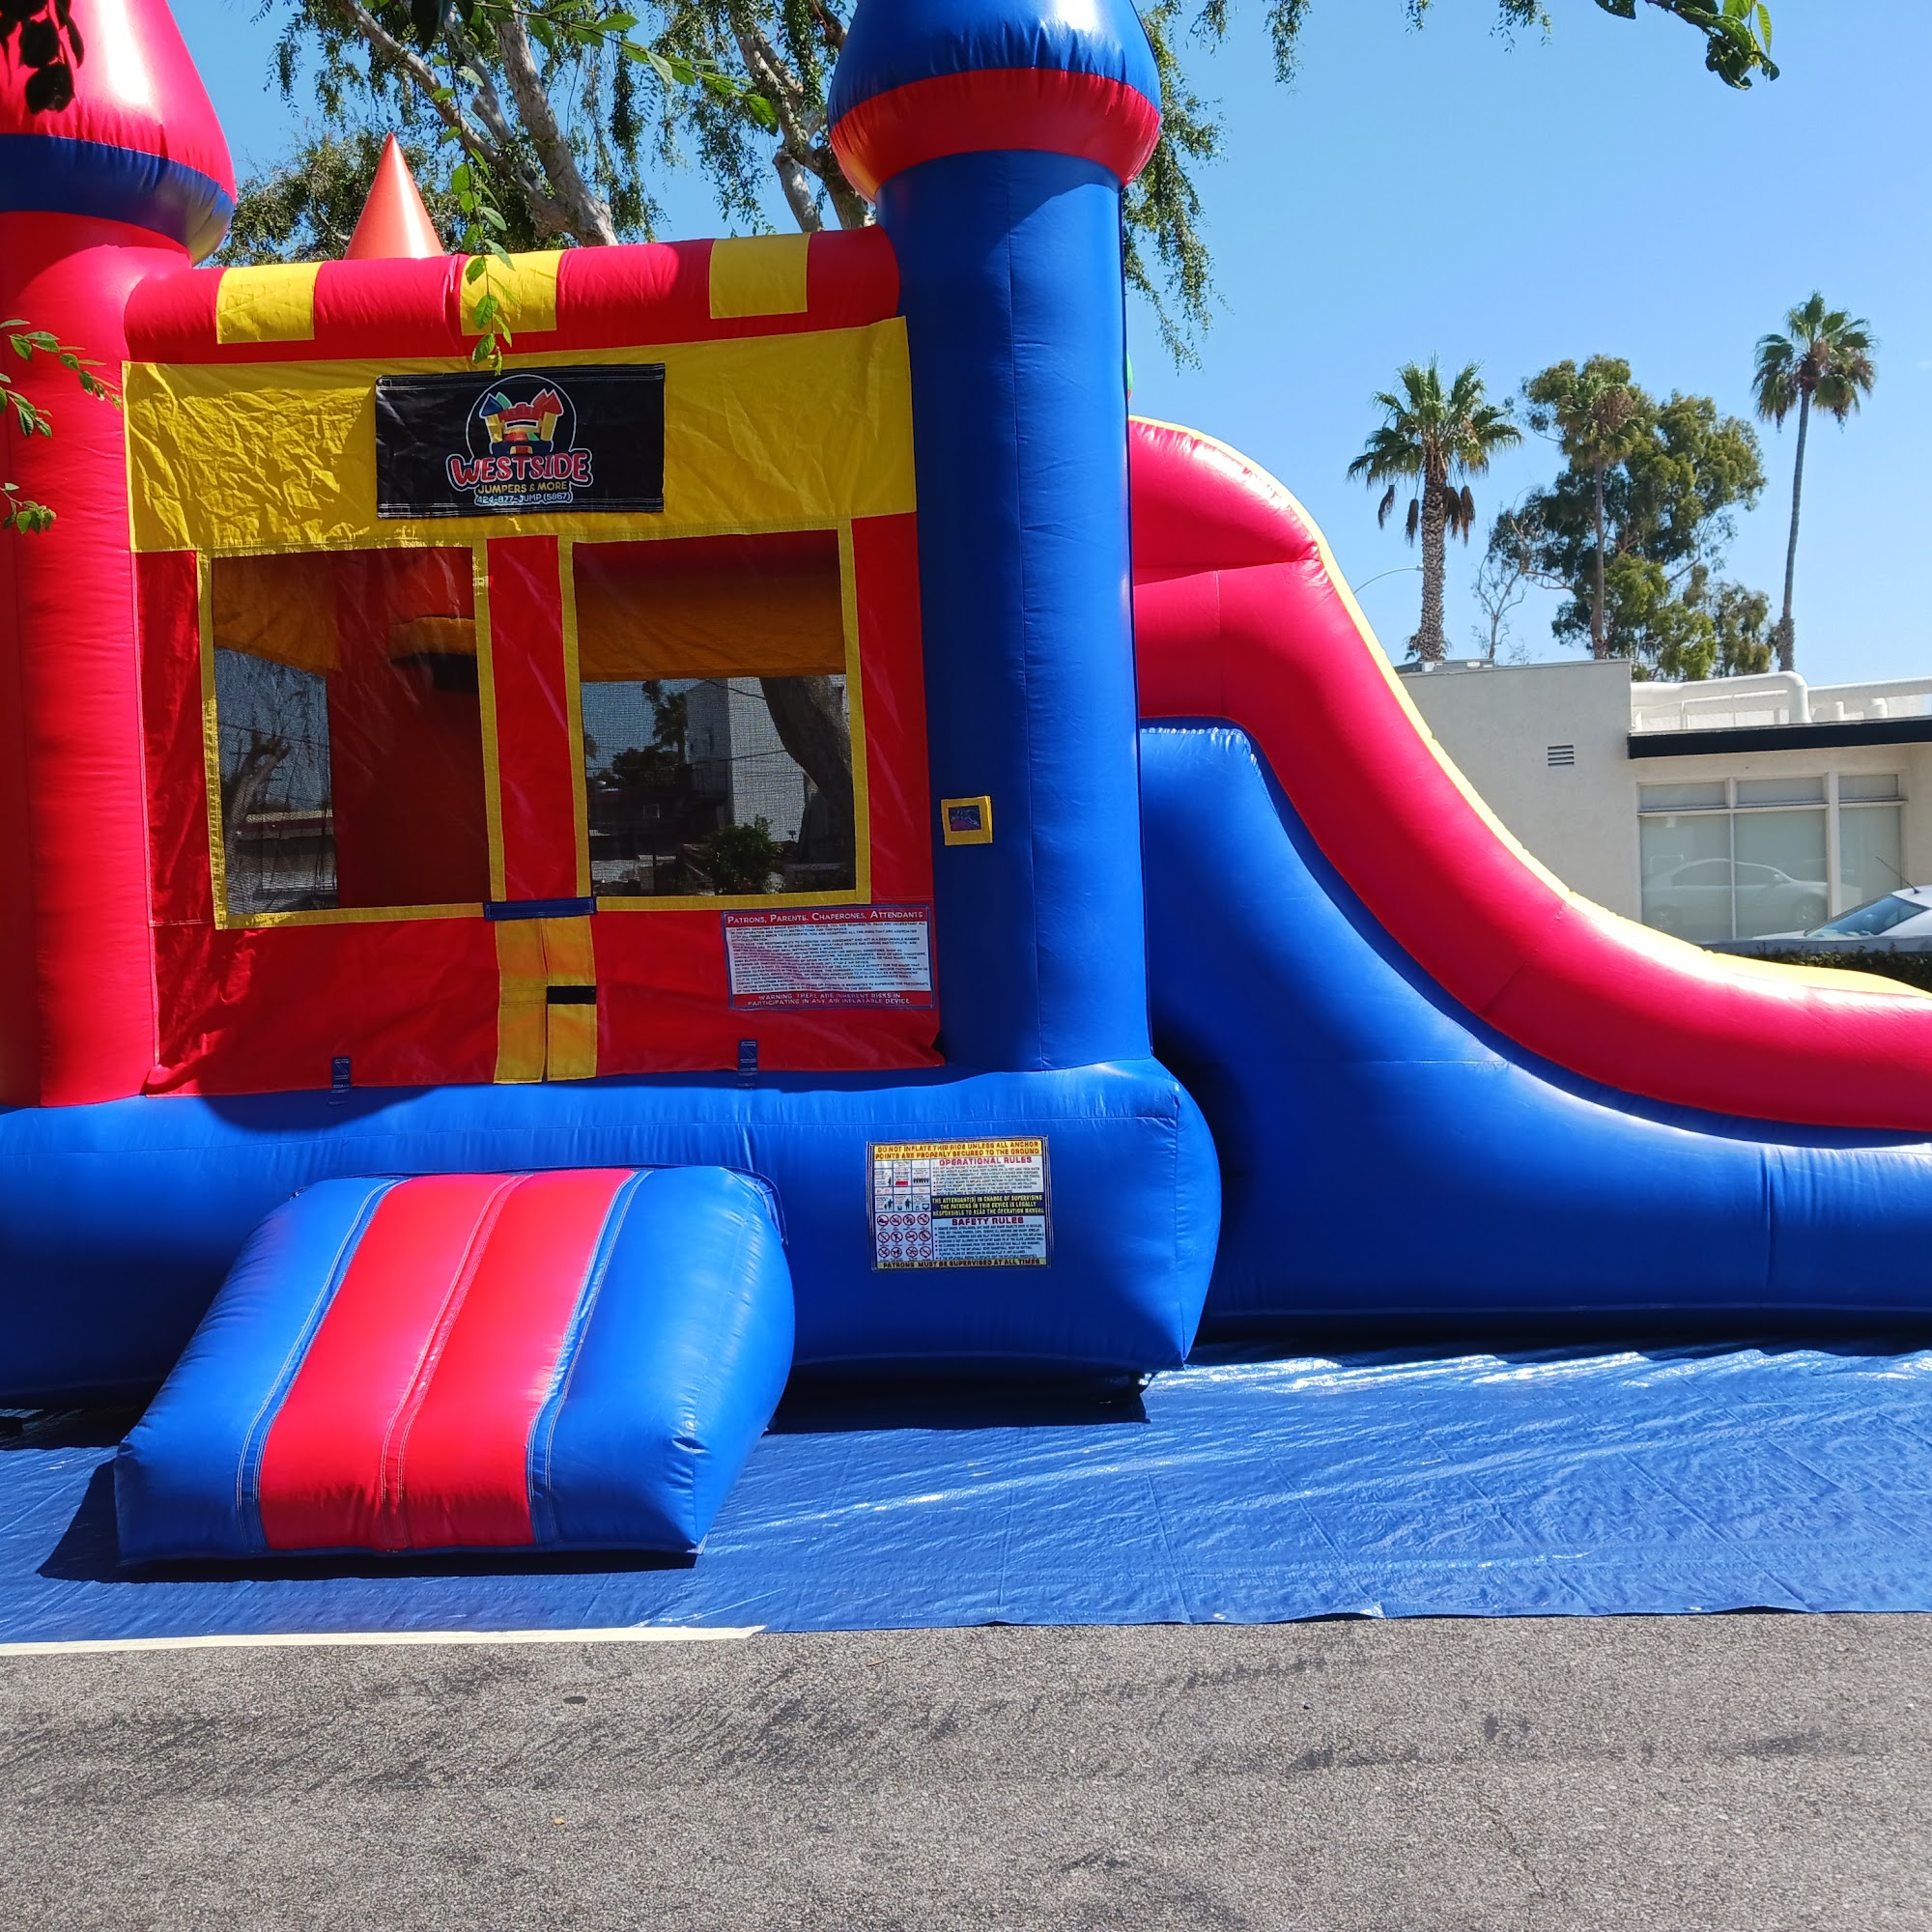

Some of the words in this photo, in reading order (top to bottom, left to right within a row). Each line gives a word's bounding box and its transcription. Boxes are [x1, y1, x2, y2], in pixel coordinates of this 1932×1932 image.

[450, 452, 589, 485] WESTSIDE
[477, 484, 527, 495] JUMPERS
[537, 481, 567, 491] MORE
[477, 493, 541, 504] 424-877-JUMP
